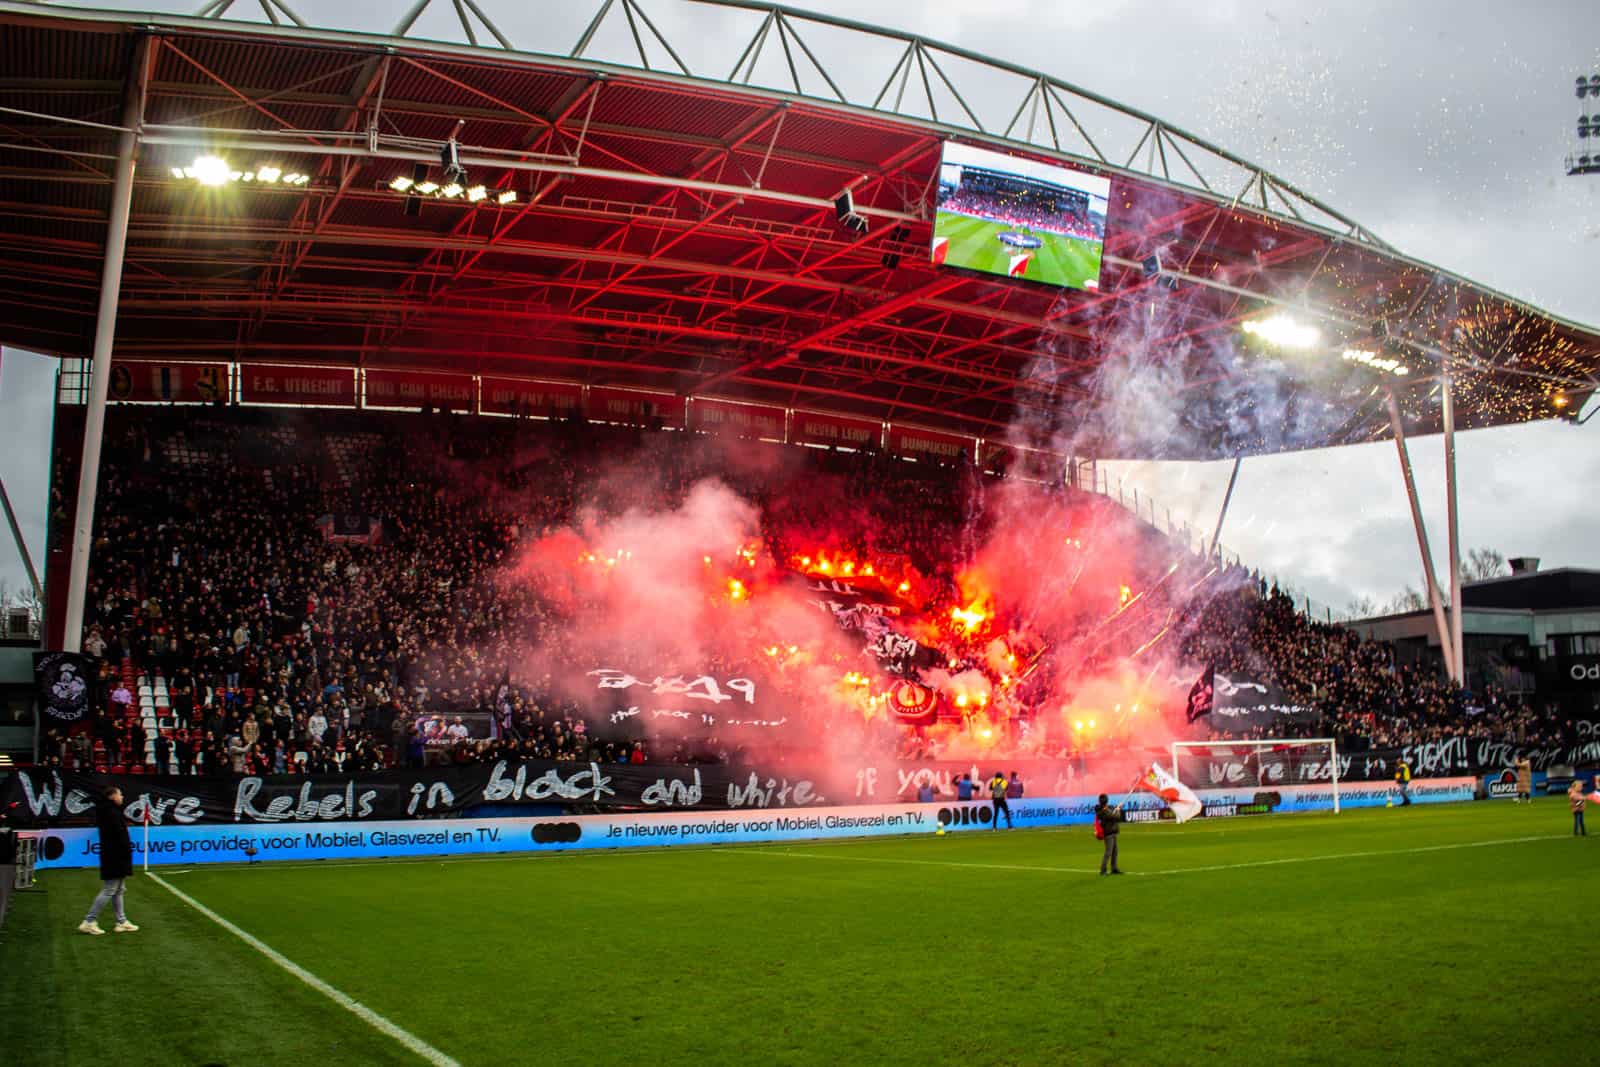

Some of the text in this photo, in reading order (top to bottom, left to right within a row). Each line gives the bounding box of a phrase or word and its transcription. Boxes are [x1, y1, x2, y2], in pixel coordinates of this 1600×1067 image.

[285, 378, 343, 395] UTRECHT
[370, 380, 470, 400] YOU CAN CHECK
[493, 391, 515, 404] OUT
[608, 399, 629, 413] YOU
[806, 424, 838, 439] NEVER
[902, 436, 961, 456] BUNNIKSID
[18, 769, 97, 817] We
[123, 792, 205, 825] are
[233, 776, 378, 821] Rebels
[407, 781, 454, 815] in
[482, 759, 616, 802] black
[641, 767, 702, 806] and
[1016, 806, 1056, 819] nieuwe
[1057, 802, 1097, 818] provide
[1125, 809, 1160, 821] UNIBET
[1206, 805, 1237, 817] UNIBET
[605, 811, 925, 838] Je nieuwe provider voor Mobiel, Glasvezel en TV.
[82, 839, 100, 856] Je
[180, 833, 257, 856] provider
[261, 836, 303, 850] voor
[370, 829, 449, 847] Glasvezel
[453, 831, 474, 842] en
[476, 826, 503, 842] TV.
